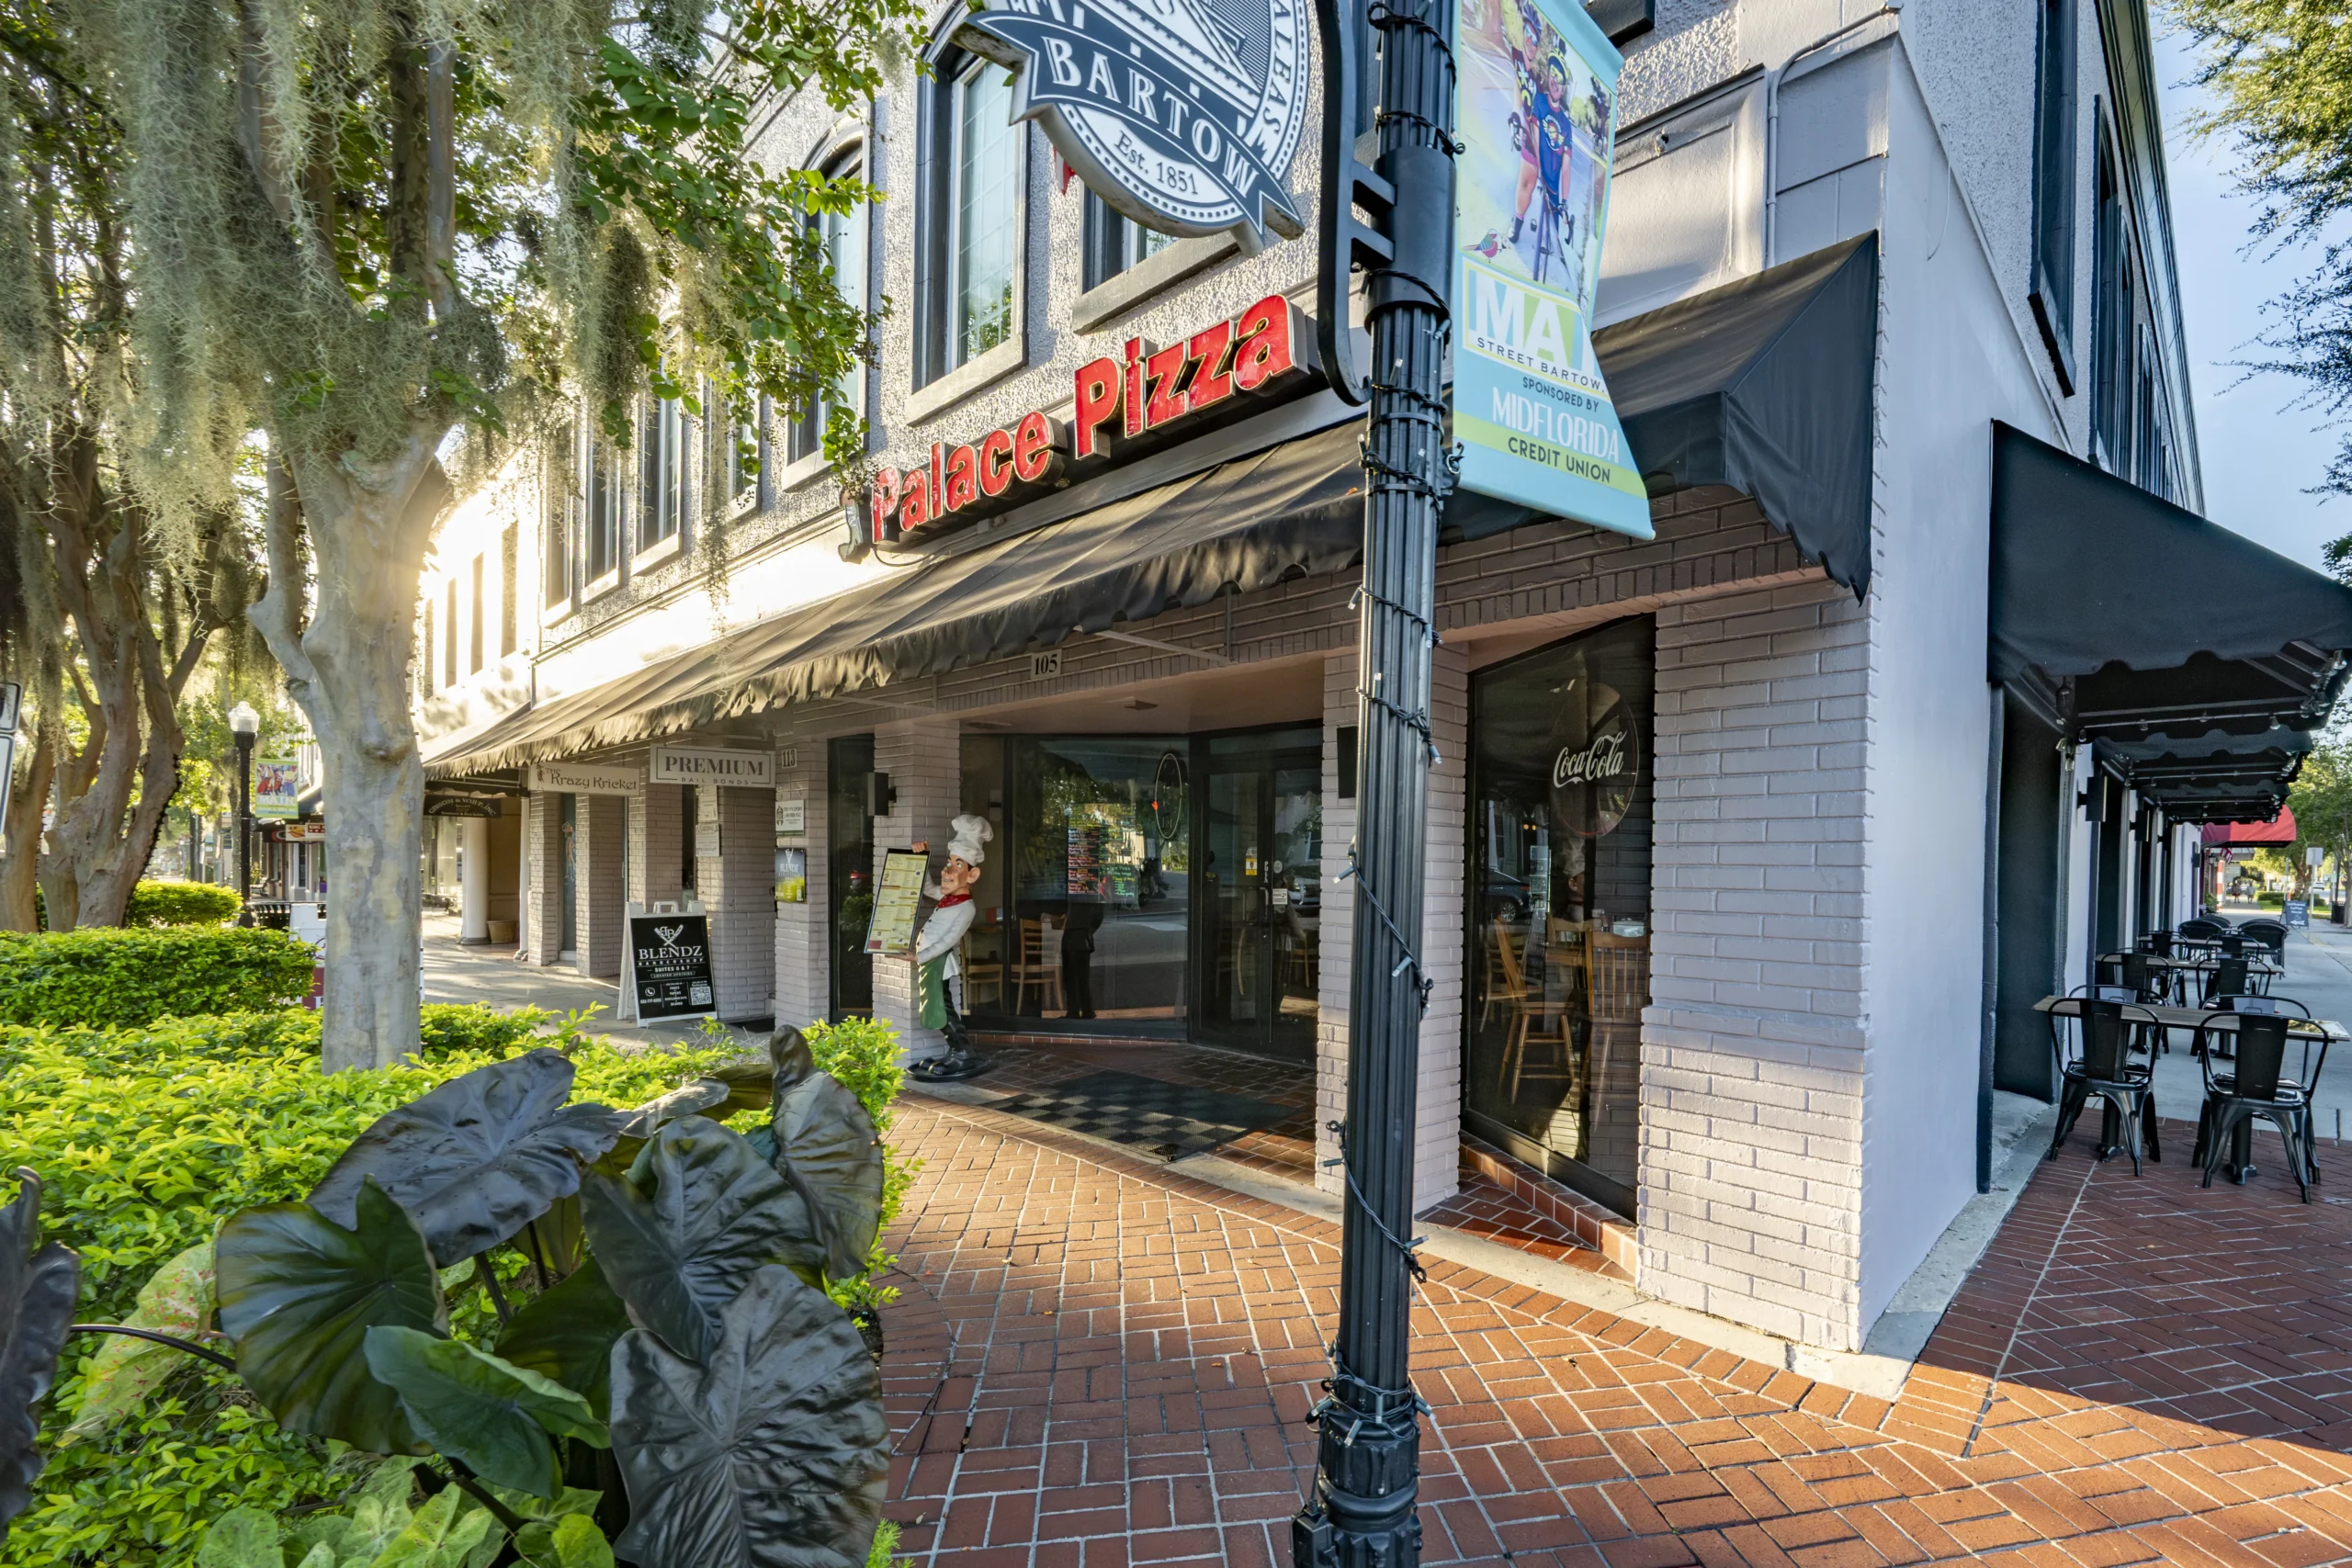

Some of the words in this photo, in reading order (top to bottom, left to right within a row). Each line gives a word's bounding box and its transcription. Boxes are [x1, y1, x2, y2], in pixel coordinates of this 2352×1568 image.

[1040, 36, 1259, 198] BARTOW
[1114, 130, 1149, 175] Est.
[1156, 161, 1199, 196] 1851
[1477, 337, 1533, 367] STREET
[1522, 377, 1583, 408] SPONSORED
[1586, 398, 1600, 412] BY
[872, 411, 1057, 543] Palace
[1074, 294, 1295, 459] Pizza
[1492, 386, 1619, 464] MIDFLORIDA
[1508, 436, 1560, 468] CREDIT
[1566, 454, 1611, 483] UNION
[1035, 653, 1058, 675] 105
[665, 756, 764, 776] PREMIUM
[783, 750, 796, 768] 113
[1553, 730, 1628, 788] Coca-Cola
[551, 773, 590, 789] Krazy
[428, 797, 454, 814] GIBSON
[638, 958, 704, 966] BARBERSHOP
[639, 945, 703, 959] BLENDZ
